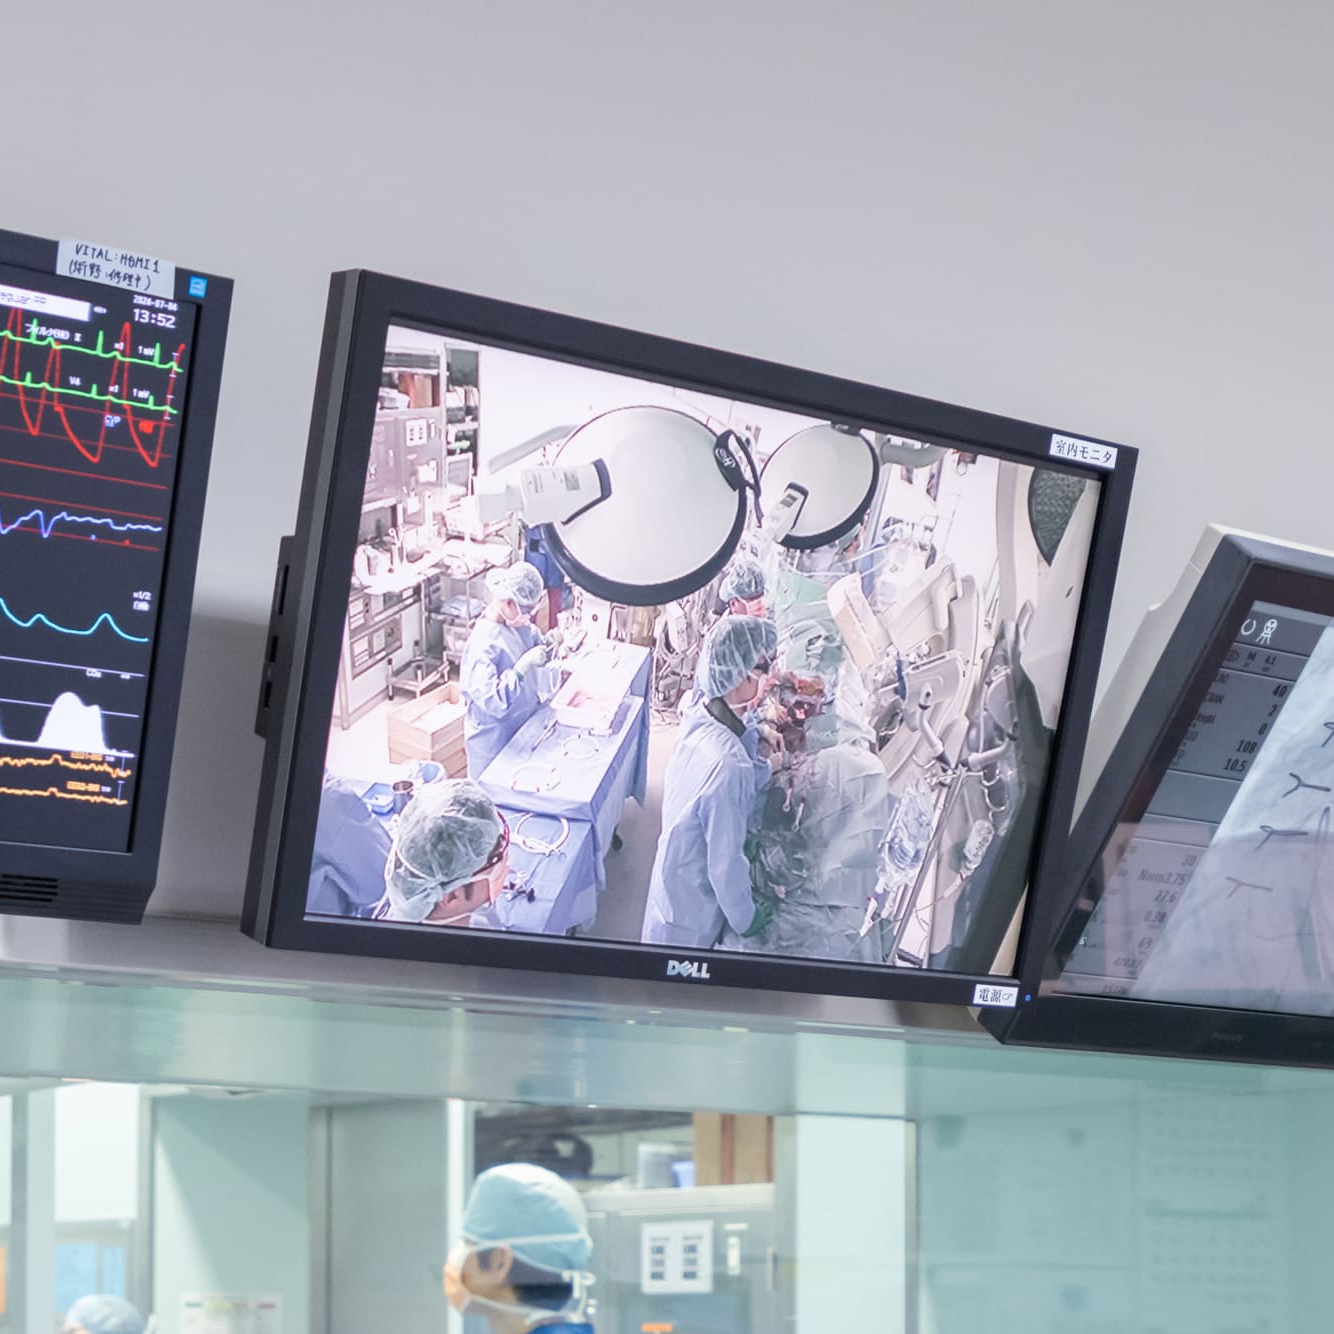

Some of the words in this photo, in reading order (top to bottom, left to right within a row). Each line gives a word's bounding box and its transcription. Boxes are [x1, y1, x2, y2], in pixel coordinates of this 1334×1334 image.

[133, 309, 176, 329] 13:52
[1055, 439, 1113, 463] 室内モニタ
[1272, 685, 1287, 698] 40
[1223, 758, 1247, 772] 10.5
[666, 959, 710, 979] DELL
[977, 987, 1002, 1004] 電源
